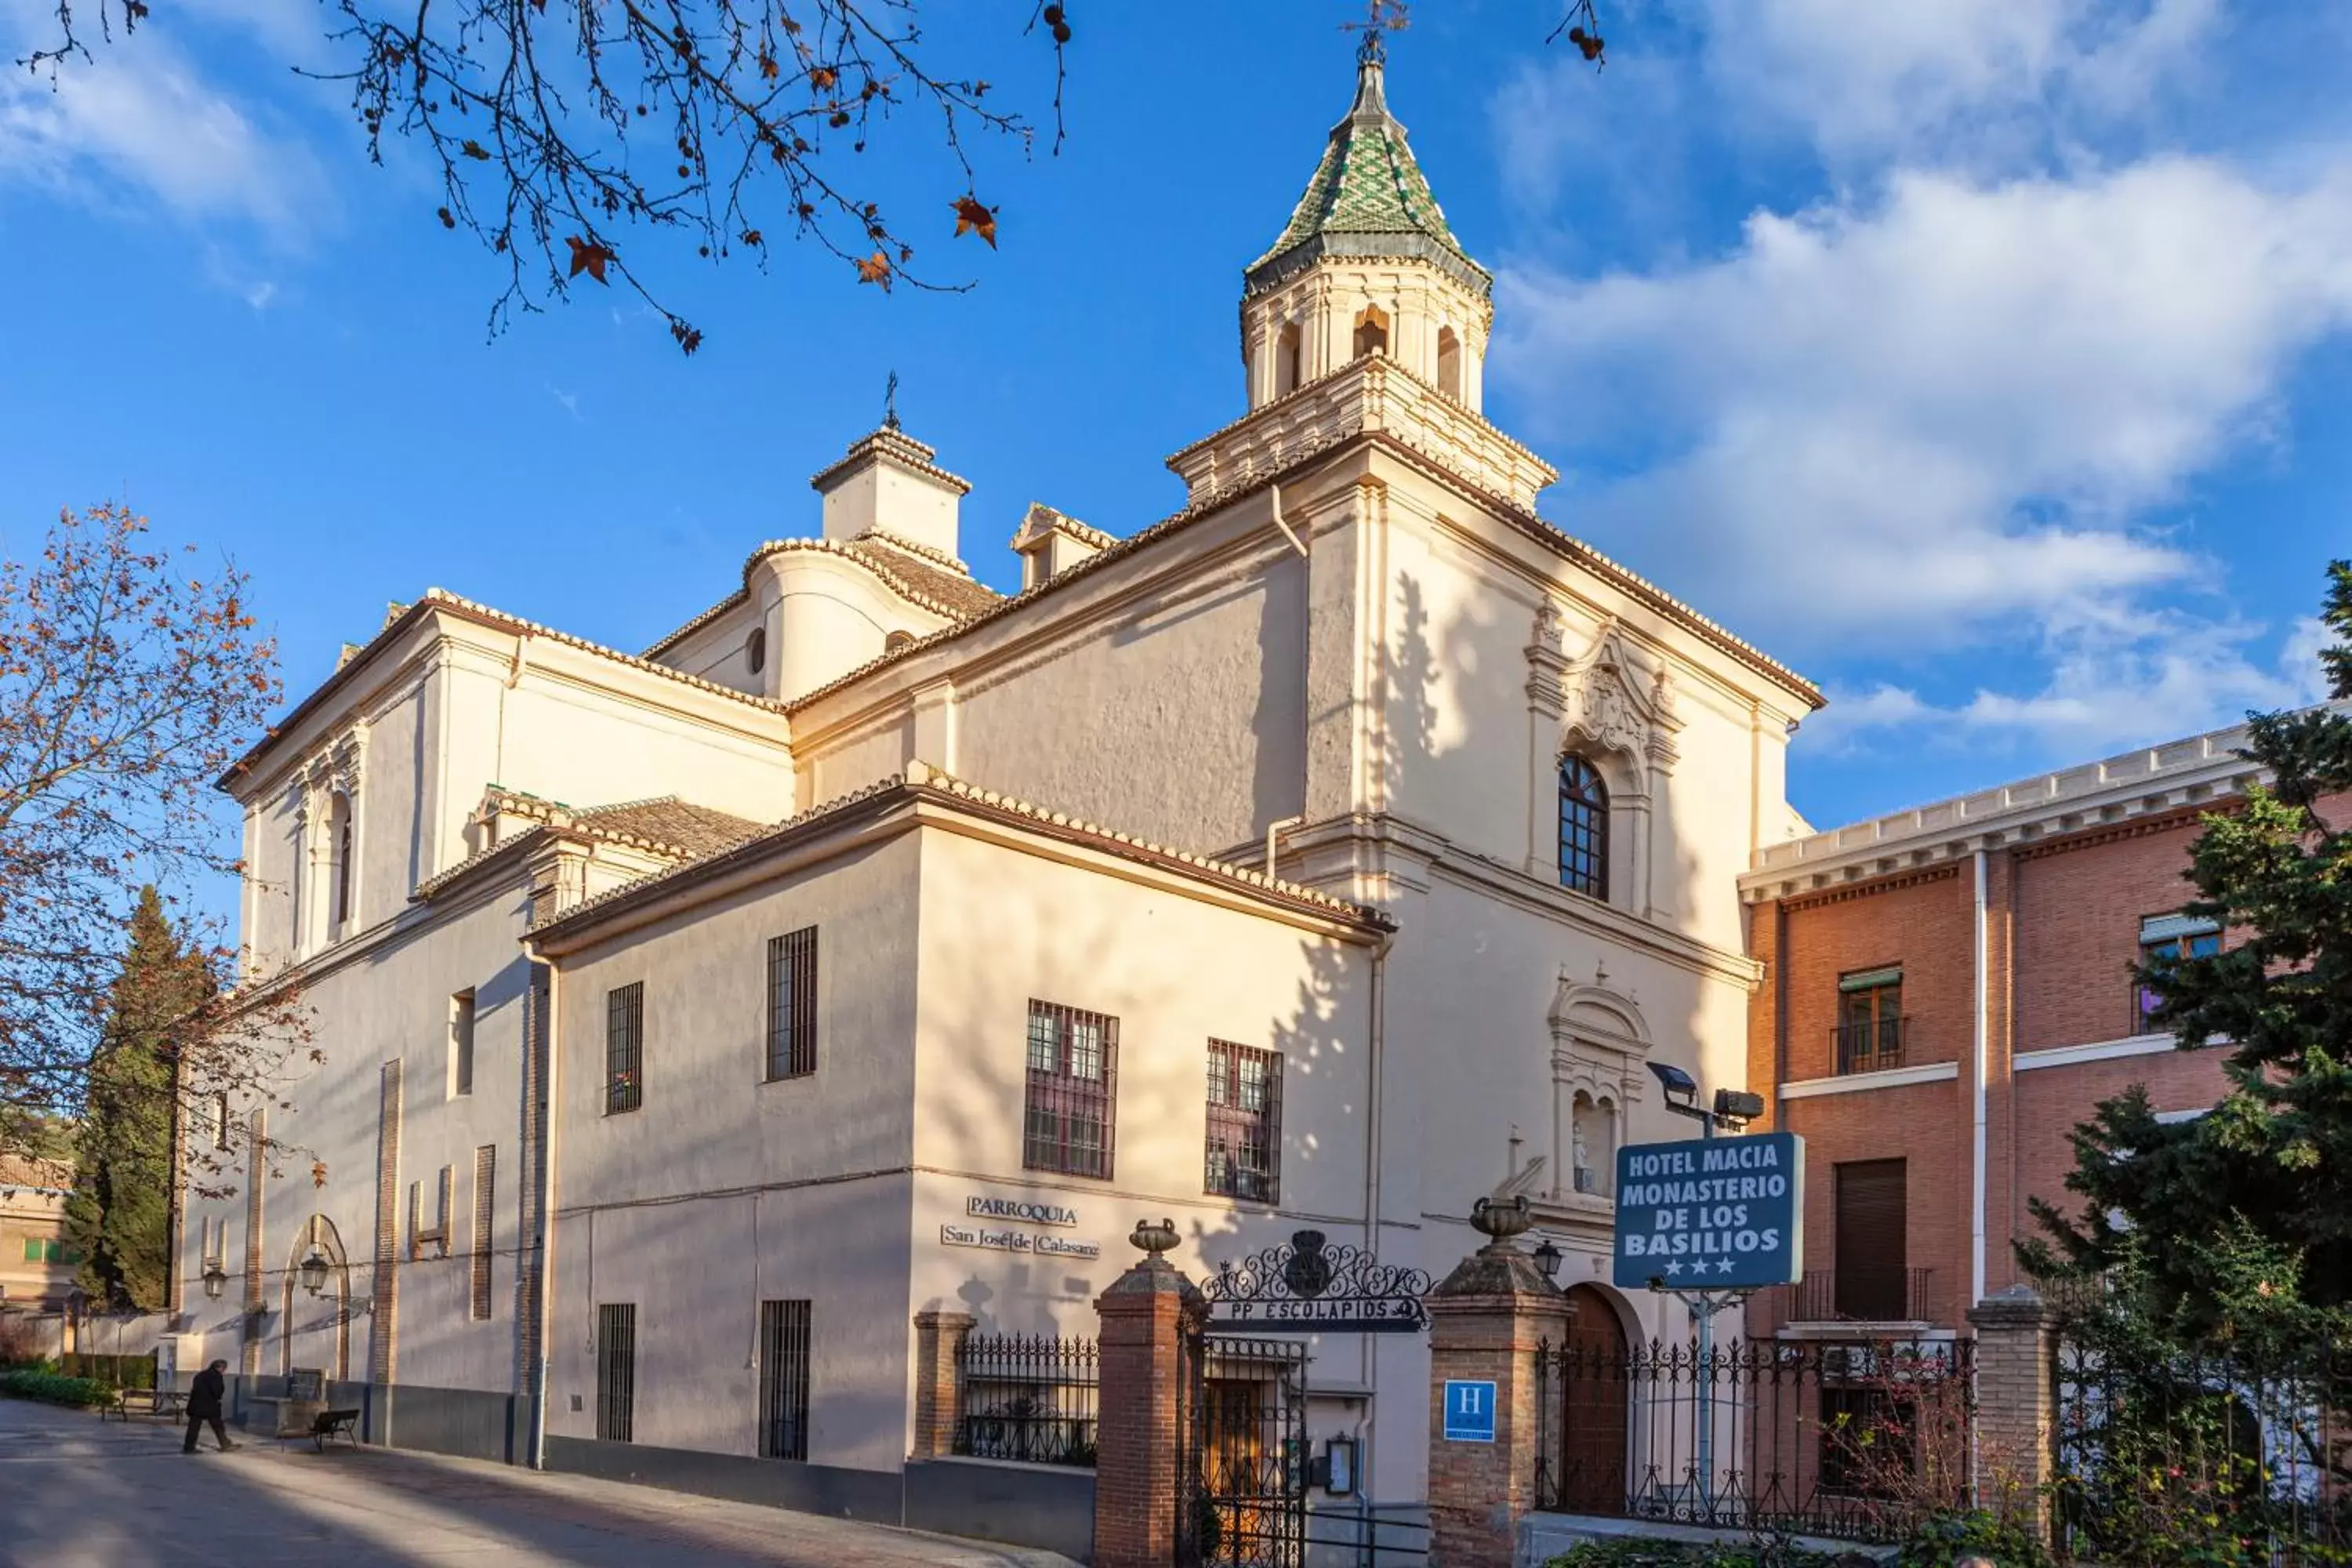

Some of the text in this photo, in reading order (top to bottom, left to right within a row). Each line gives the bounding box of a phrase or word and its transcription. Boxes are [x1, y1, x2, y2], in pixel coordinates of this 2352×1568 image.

[1629, 1144, 1778, 1178] HOTEL MACIA
[1621, 1174, 1785, 1207] MONASTERIO
[971, 1197, 1077, 1223] PARROQUIA
[1655, 1204, 1748, 1230] DE LOS
[945, 1225, 974, 1243] San
[979, 1229, 1009, 1246] José
[1014, 1233, 1031, 1249] de
[1625, 1229, 1779, 1256] BASILIOS
[1266, 1301, 1387, 1319] ESCOLAPIOS
[1457, 1386, 1483, 1414] H
